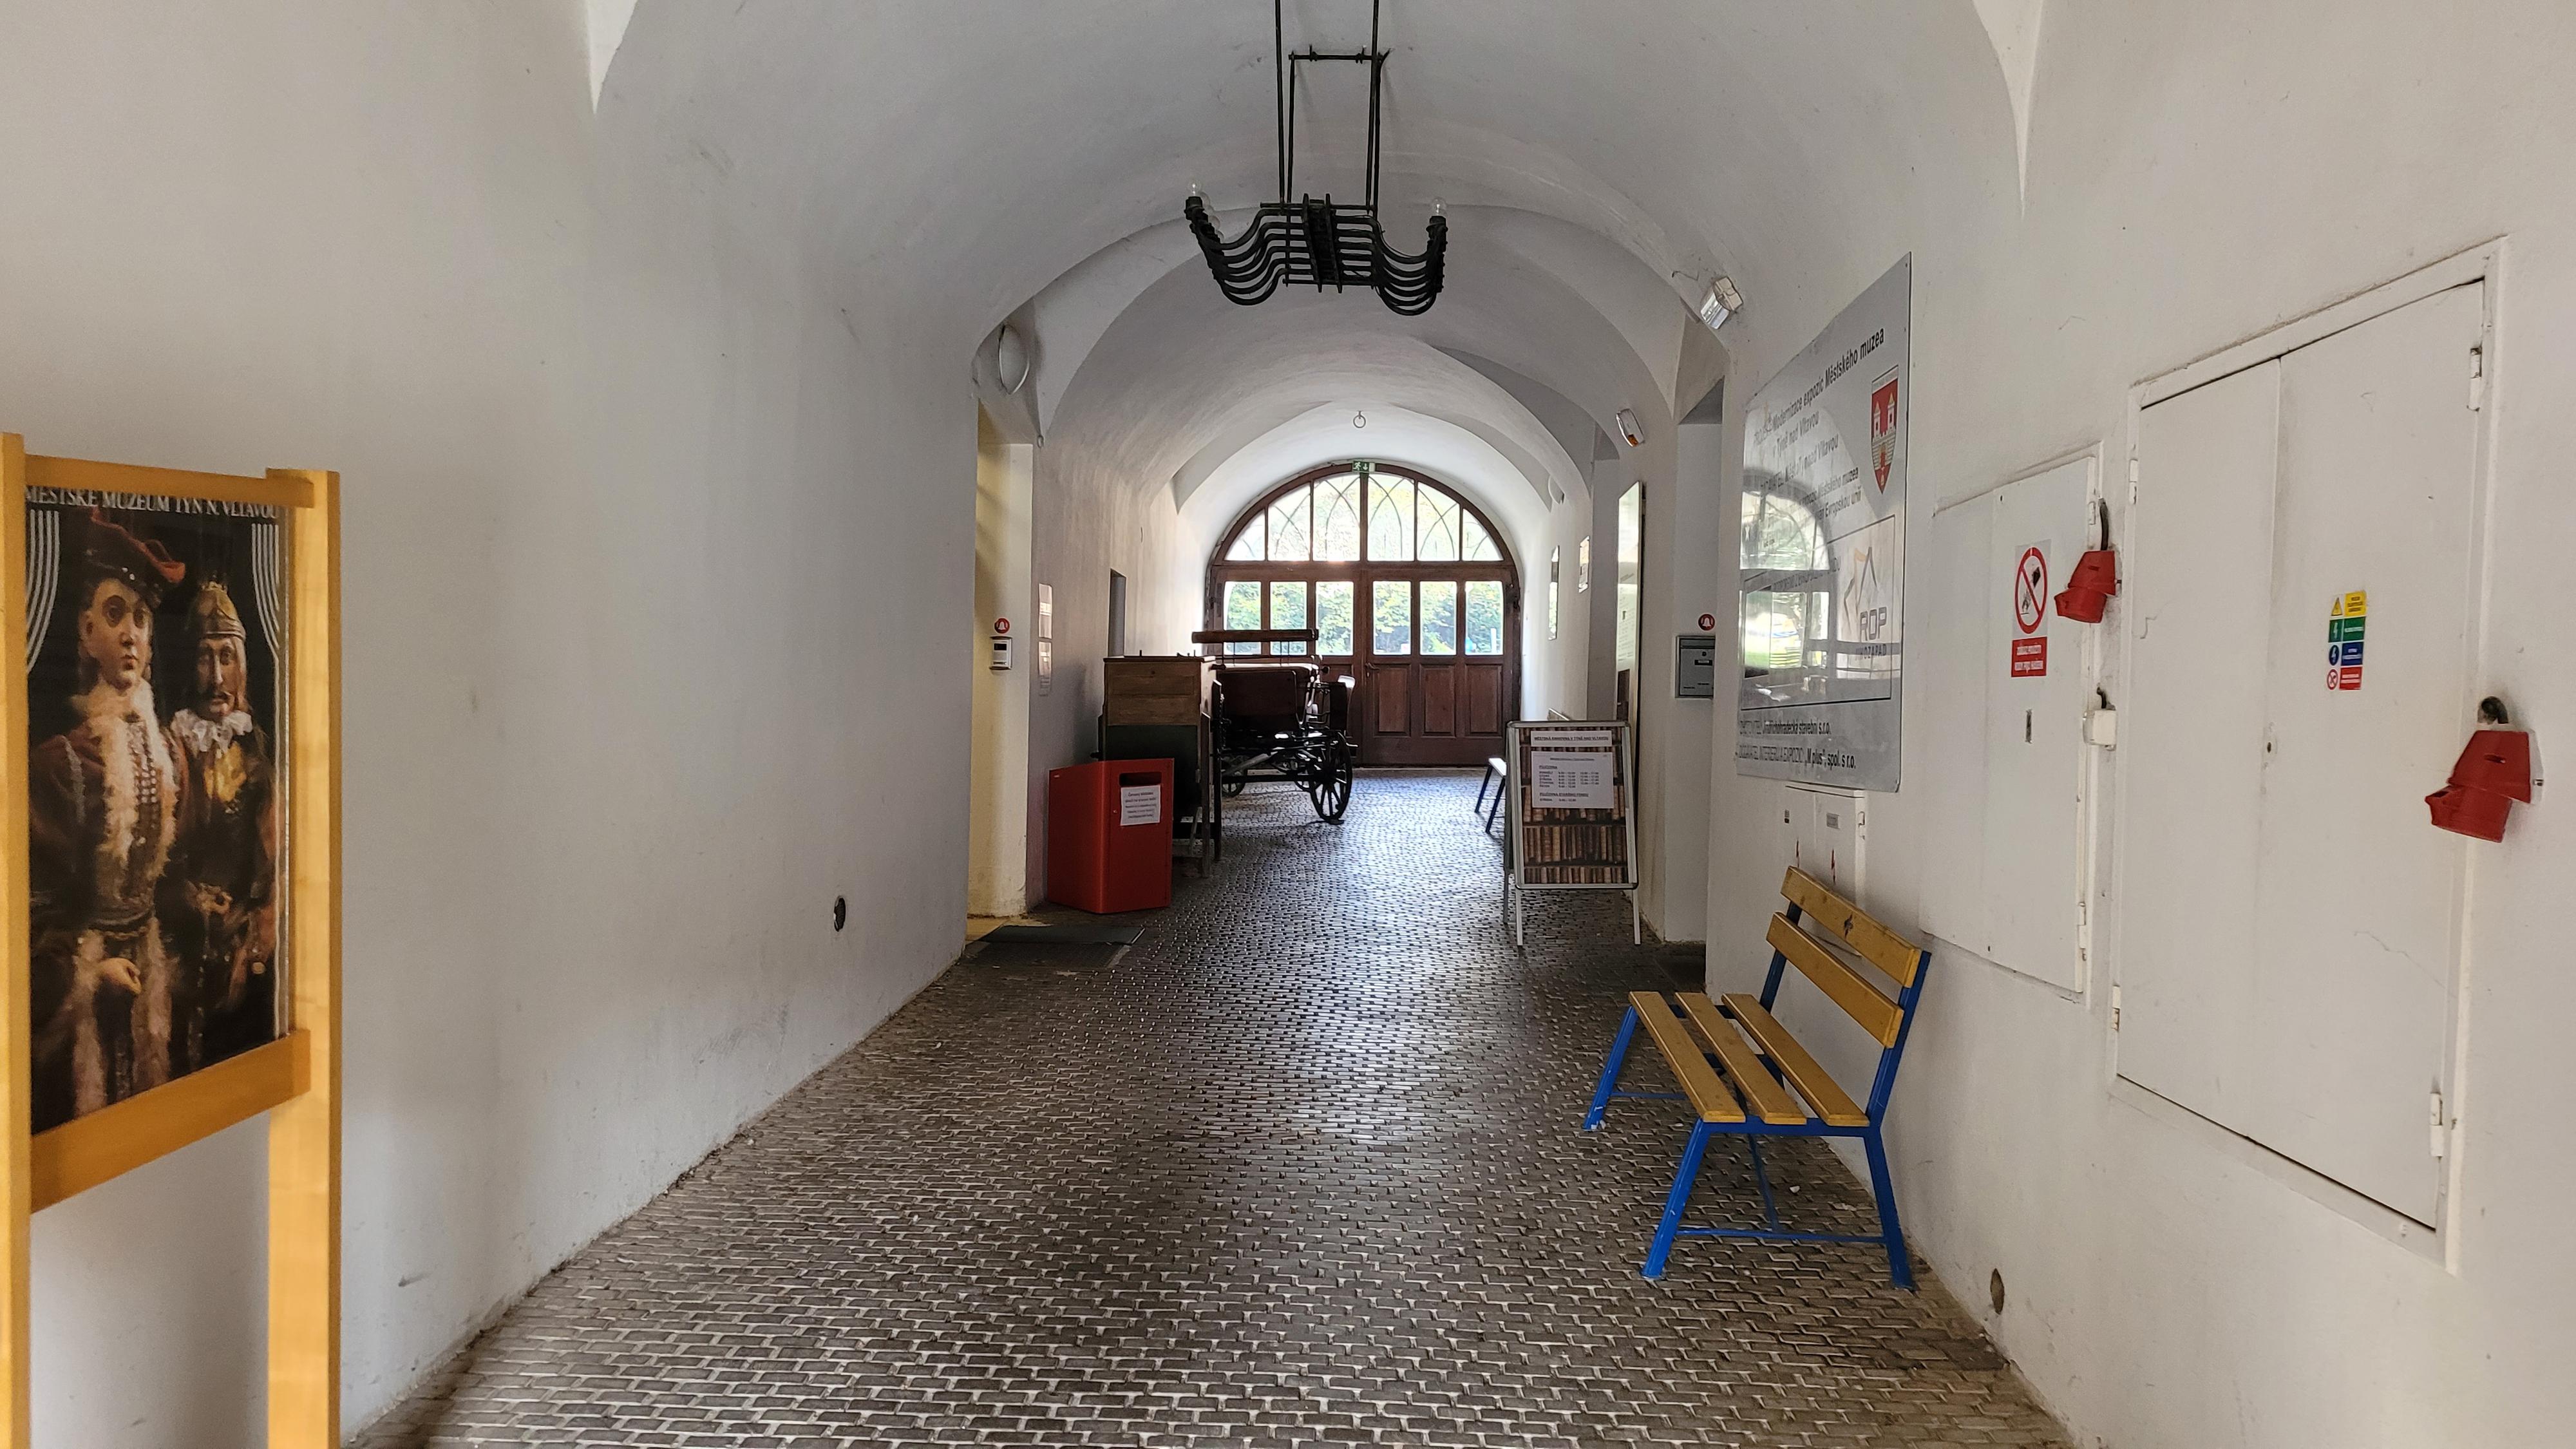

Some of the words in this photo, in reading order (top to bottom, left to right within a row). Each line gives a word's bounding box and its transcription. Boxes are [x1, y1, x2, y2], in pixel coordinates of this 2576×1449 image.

[1803, 376, 1824, 407] expozic
[1825, 348, 1858, 388] Městského
[1860, 328, 1884, 360] muzea
[1789, 422, 1798, 446] nad
[1799, 411, 1819, 437] Vltavou
[1818, 433, 1839, 459] Vltavou
[102, 490, 169, 512] MUZEUM
[1860, 607, 1887, 642] ROP
